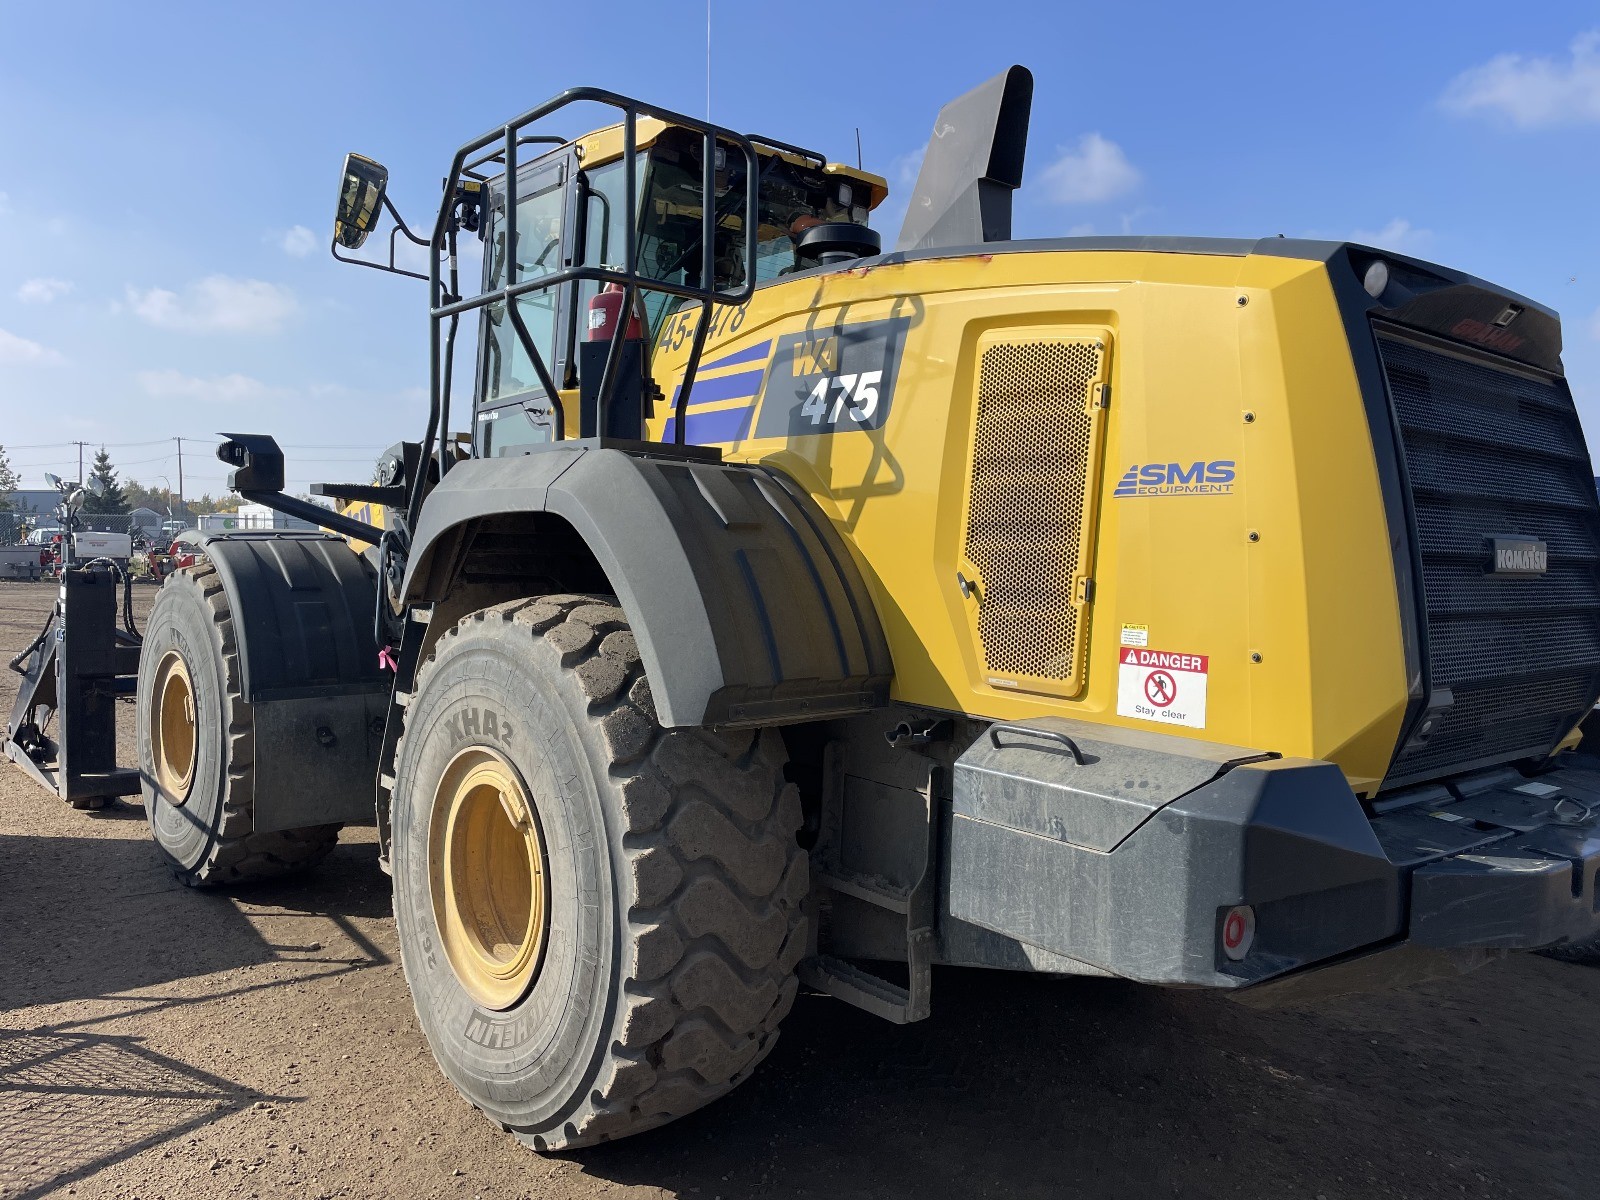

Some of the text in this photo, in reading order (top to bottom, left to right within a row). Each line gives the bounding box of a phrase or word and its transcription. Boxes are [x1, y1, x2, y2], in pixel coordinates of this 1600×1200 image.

[660, 297, 753, 354] 45-478
[792, 336, 838, 377] WA
[801, 370, 882, 425] 475
[1138, 460, 1236, 486] SMS
[1138, 484, 1234, 495] EQUIPMENT
[1496, 545, 1547, 570] KOMATSU
[1140, 651, 1202, 671] DANGER
[1135, 704, 1187, 720] Stay clear
[444, 707, 514, 750] XHA2
